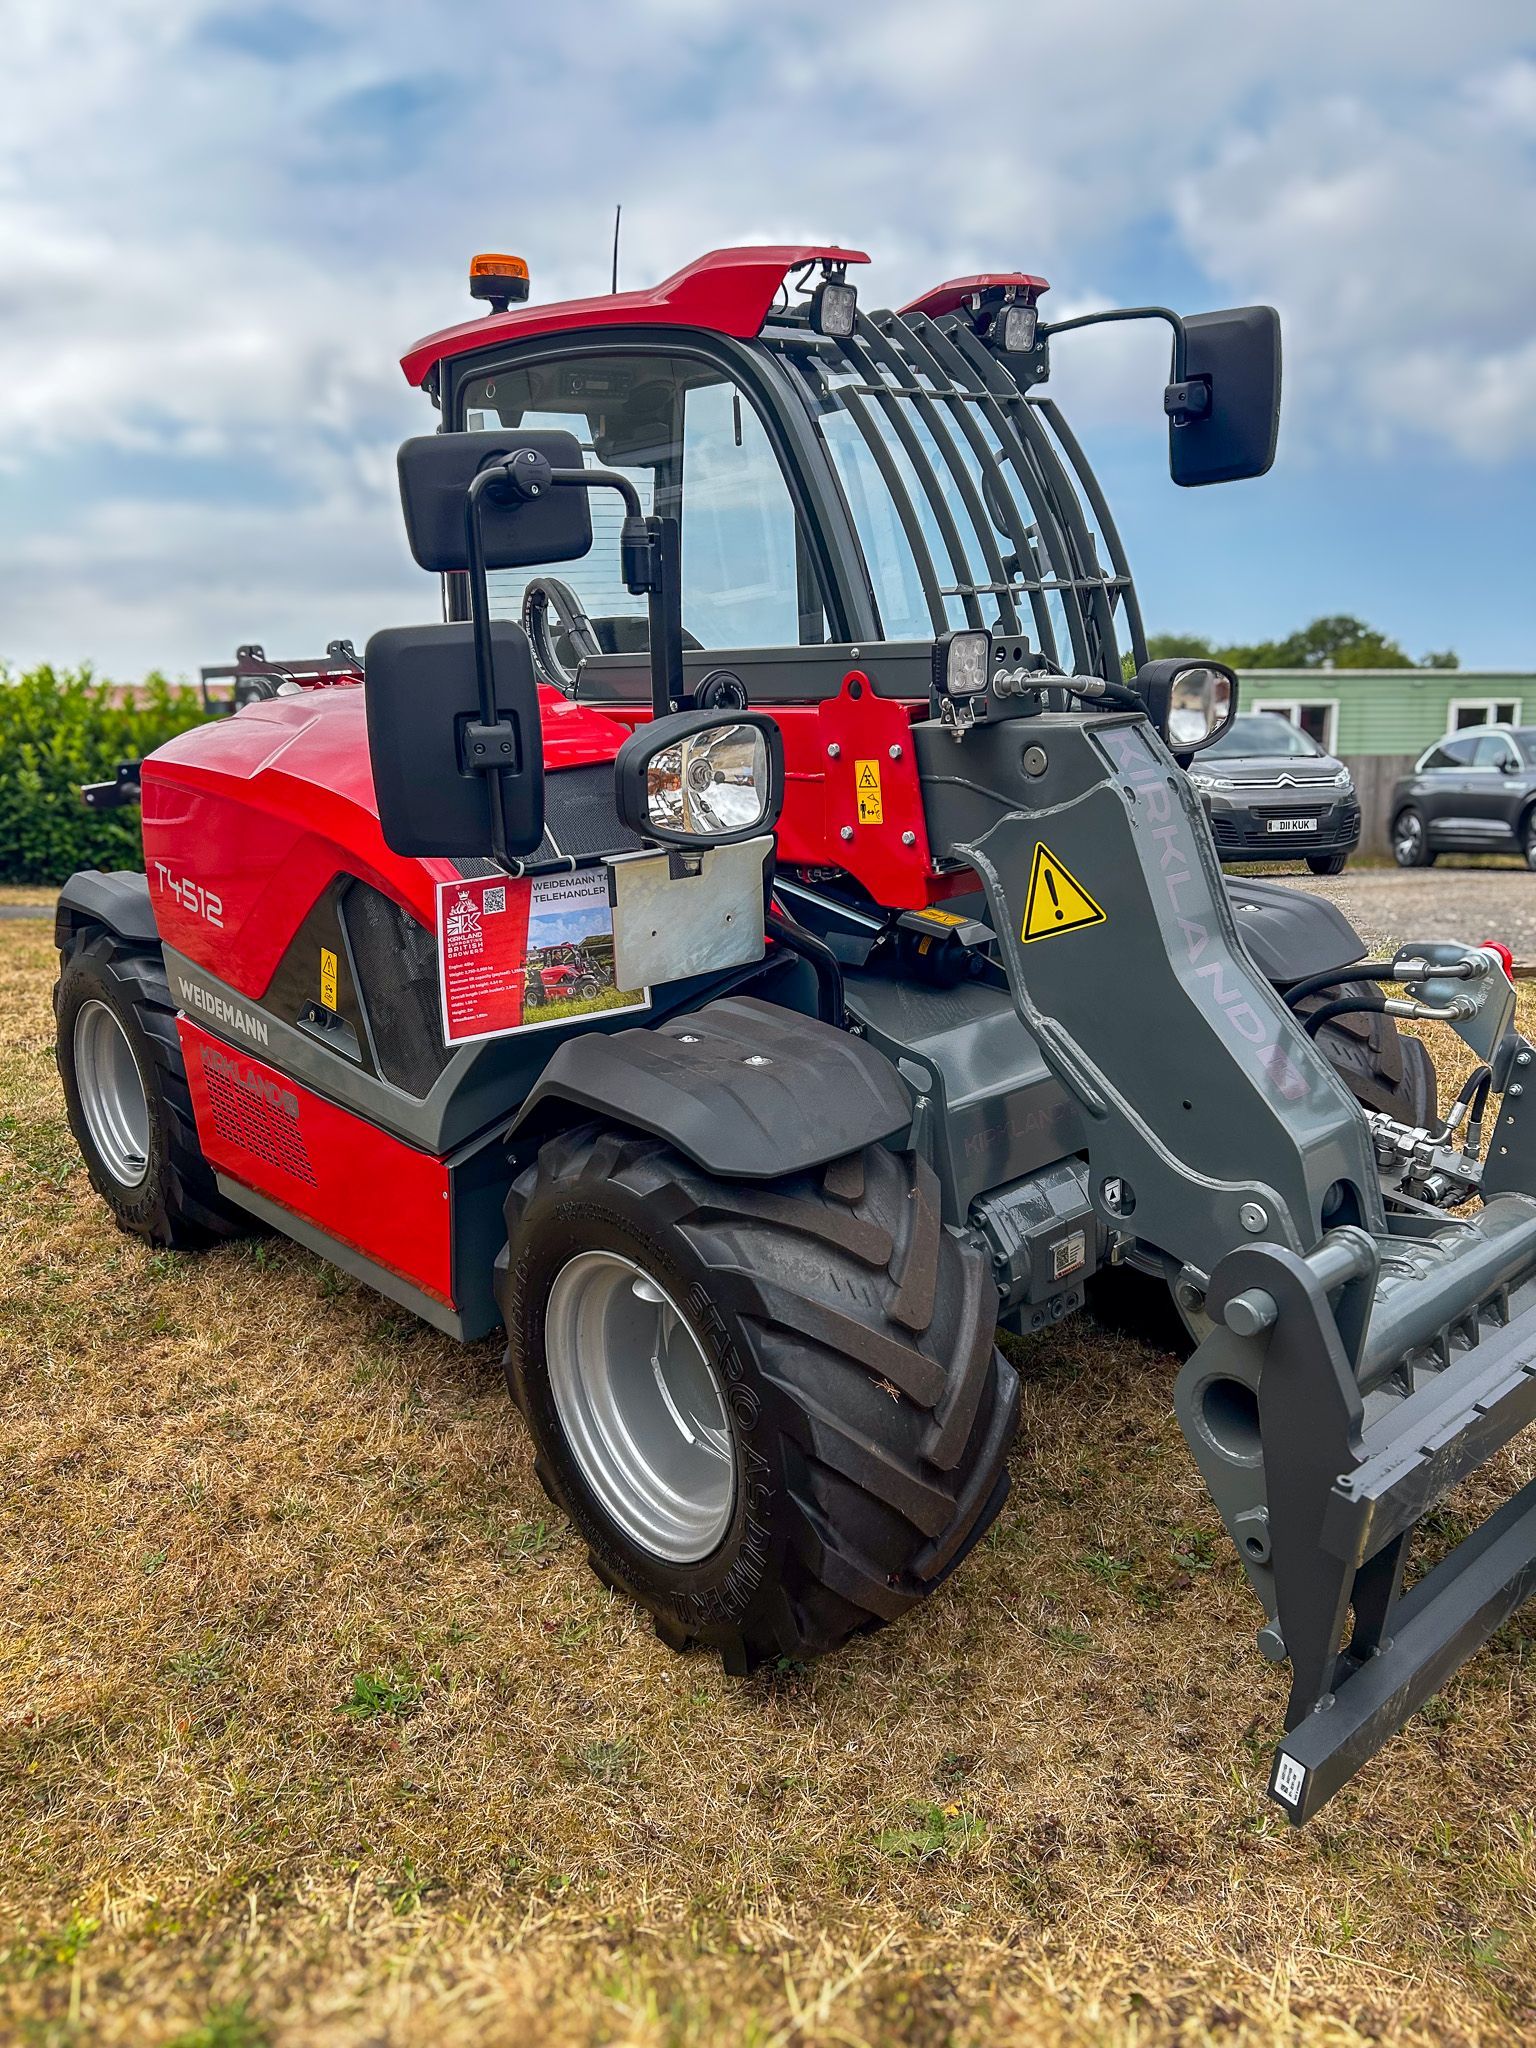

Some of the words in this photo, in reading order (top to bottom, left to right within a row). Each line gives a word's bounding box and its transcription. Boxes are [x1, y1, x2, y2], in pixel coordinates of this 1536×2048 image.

[1292, 820, 1309, 829] KUK
[532, 876, 595, 890] WEIDEMANN
[1101, 731, 1266, 1044] KIRKLAND
[154, 861, 224, 929] T4512
[533, 886, 606, 903] TELEHANDLER
[447, 932, 483, 943] KIRKLAND
[447, 942, 483, 954] BRITISH
[448, 948, 484, 958] GROWERS
[178, 976, 269, 1046] WEIDEMANN
